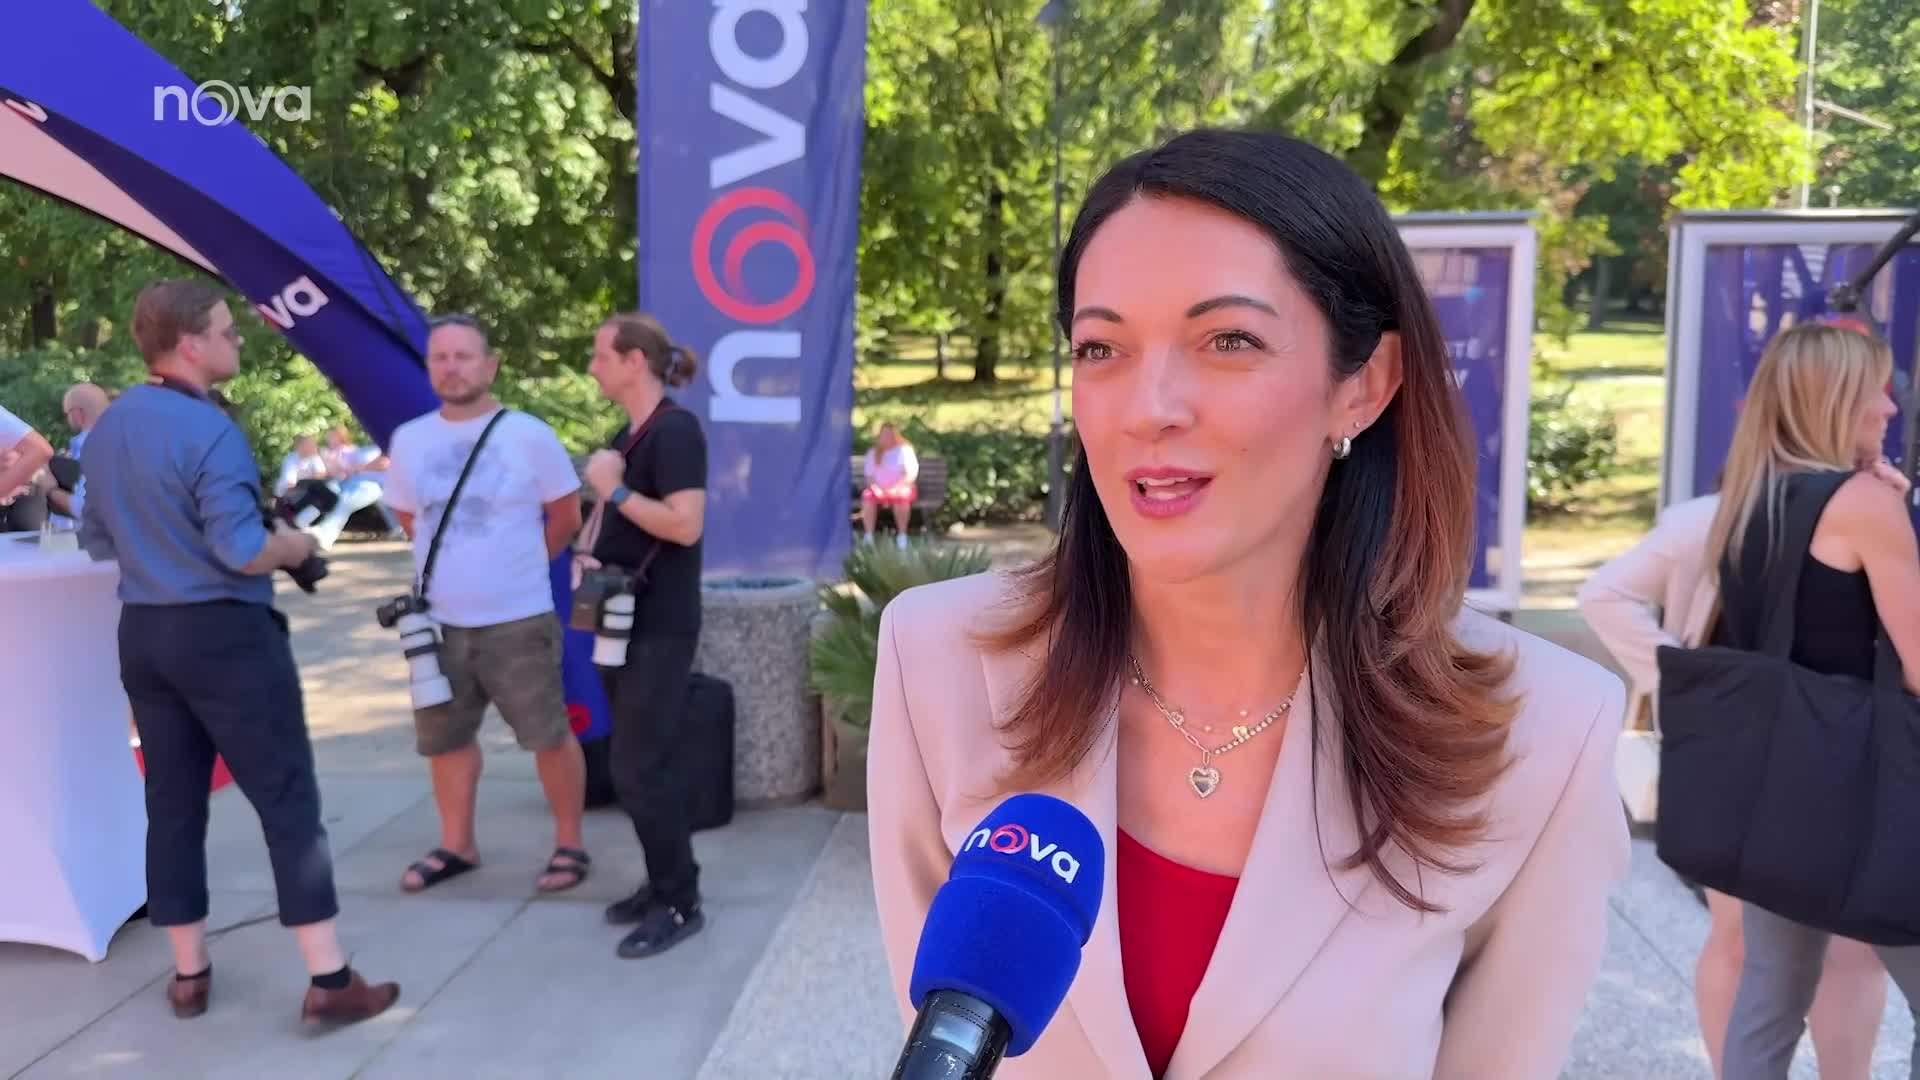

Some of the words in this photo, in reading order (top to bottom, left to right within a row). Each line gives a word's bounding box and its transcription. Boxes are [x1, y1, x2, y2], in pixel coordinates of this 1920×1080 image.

[691, 0, 816, 423] nova
[255, 274, 330, 329] va
[963, 823, 1081, 884] nova
